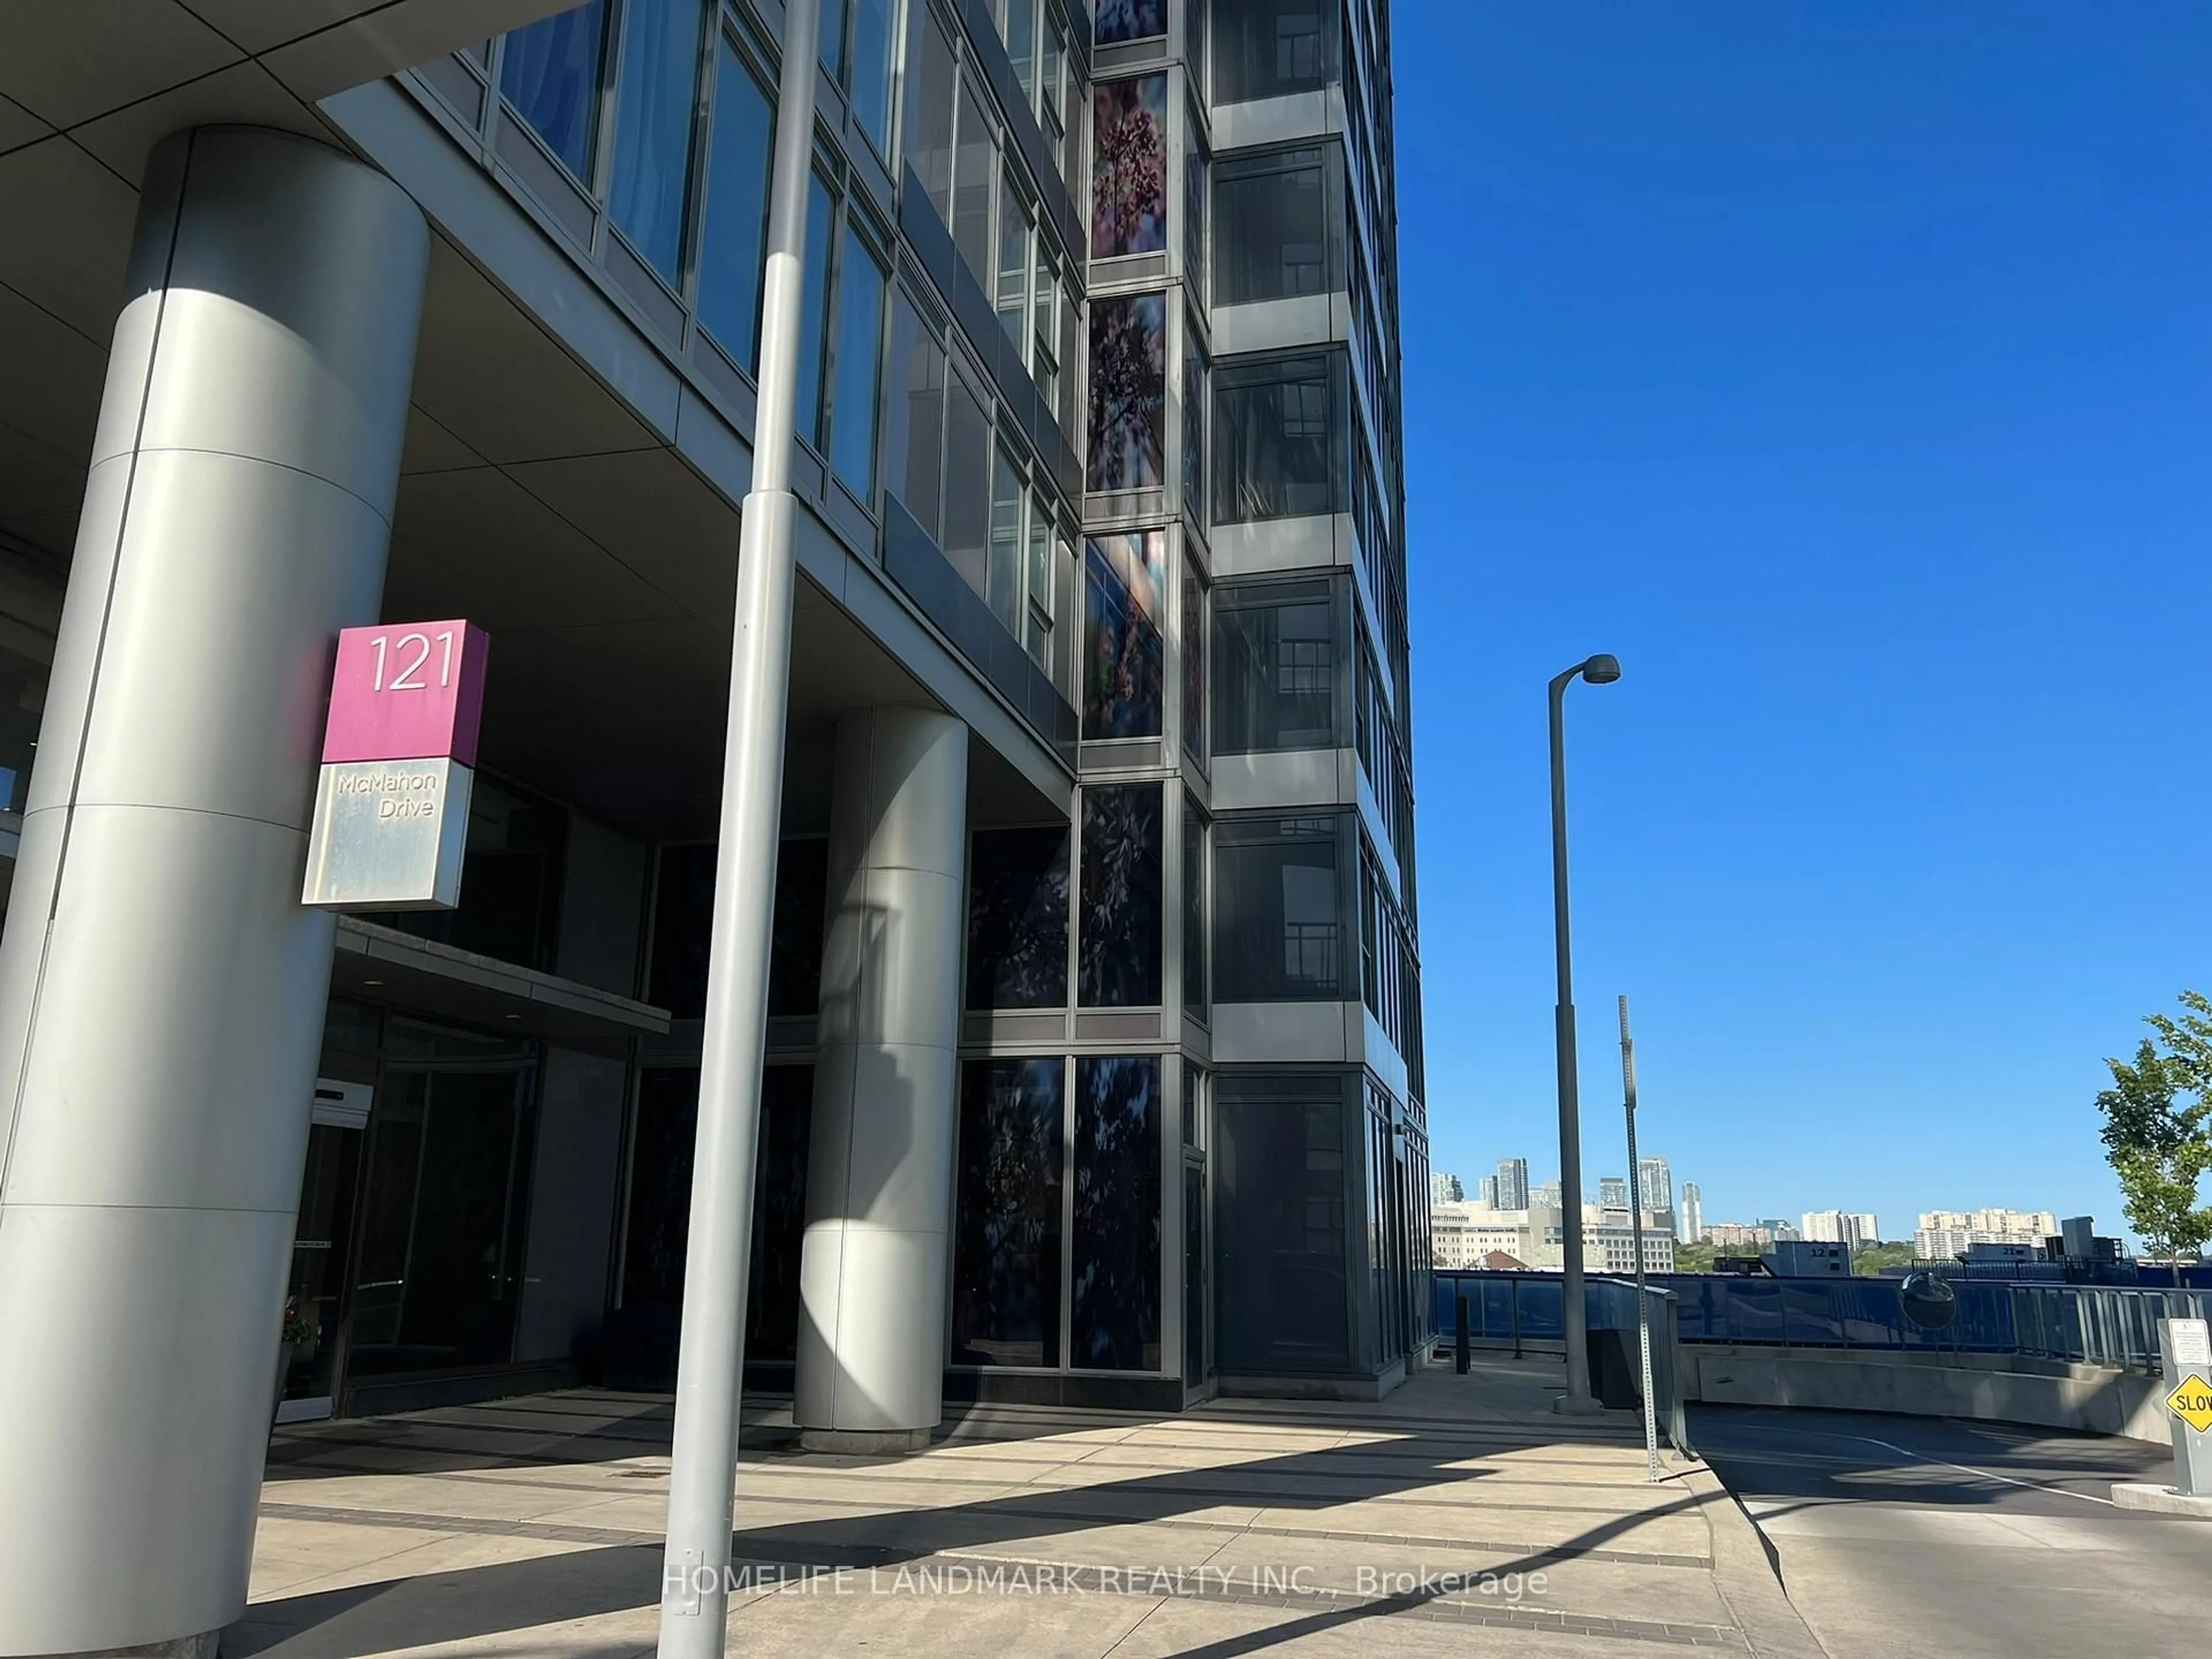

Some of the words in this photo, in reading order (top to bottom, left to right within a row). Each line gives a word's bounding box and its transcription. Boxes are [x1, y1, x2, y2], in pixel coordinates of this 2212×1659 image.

[370, 631, 454, 691] 121
[339, 772, 437, 794] McMahon
[379, 798, 434, 818] Drive
[1810, 1248, 1825, 1257] 12
